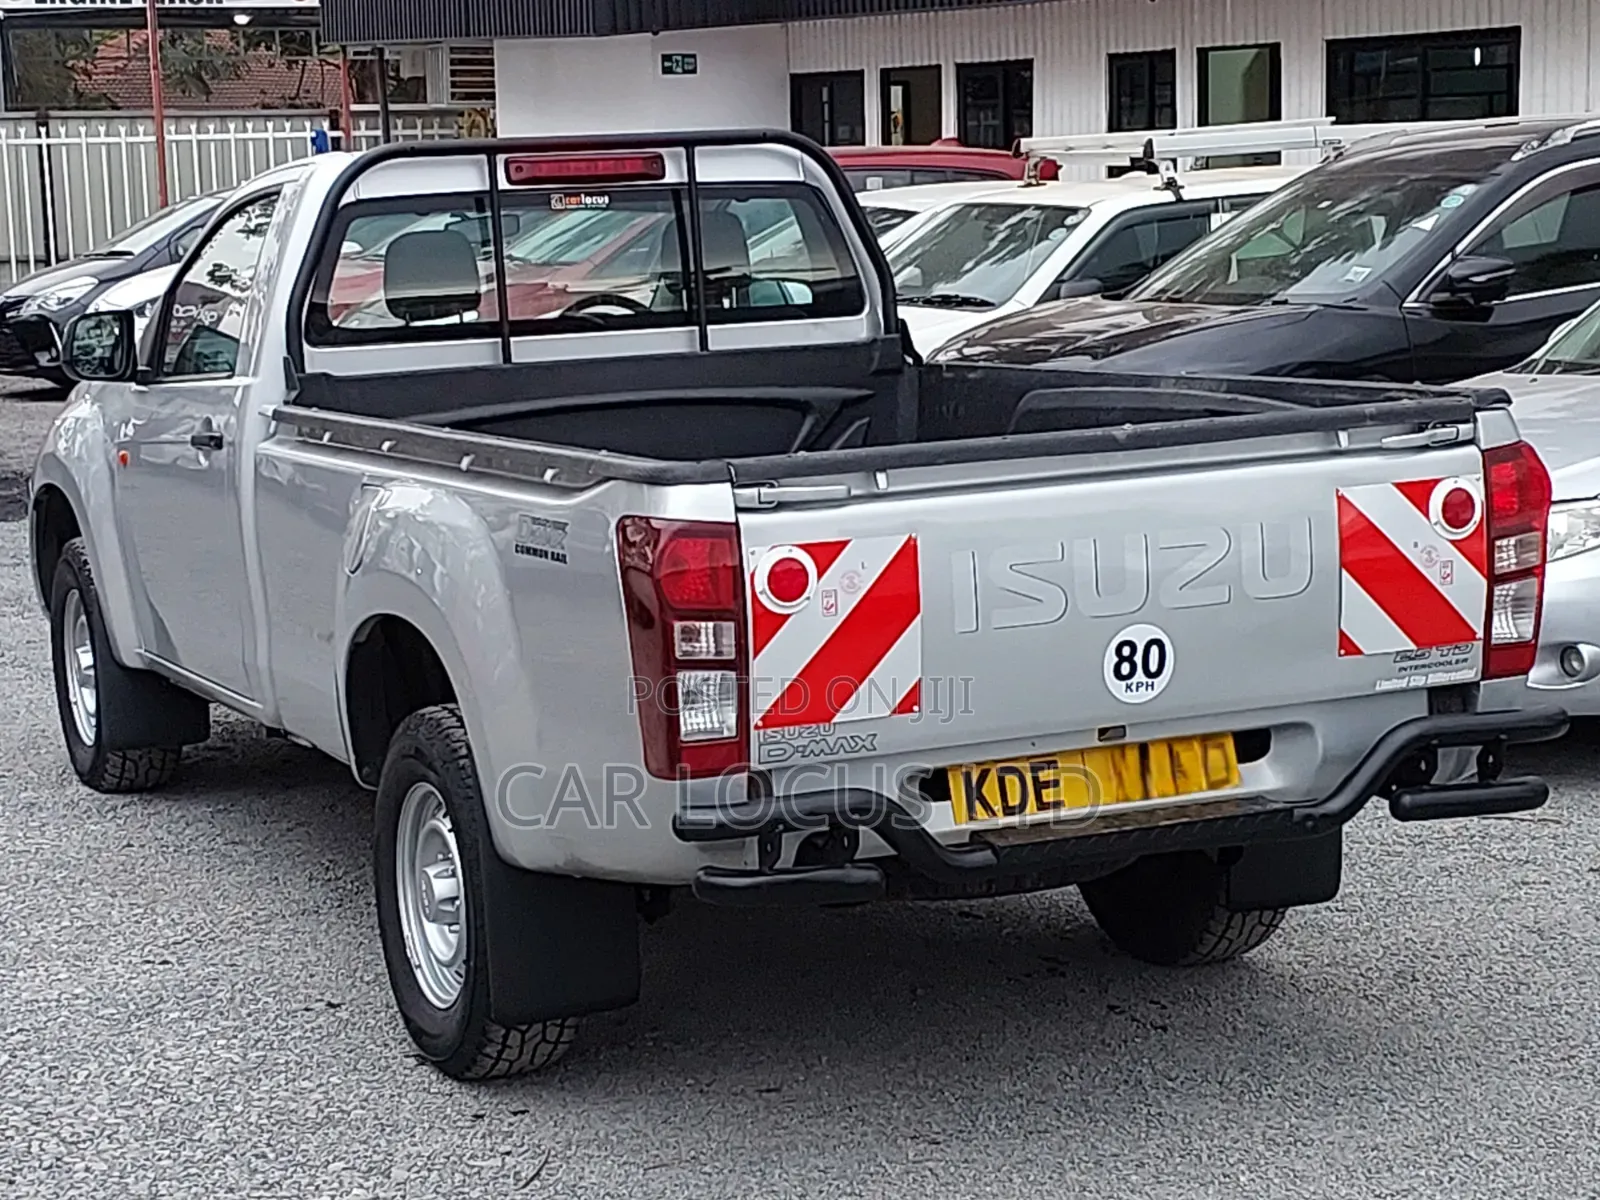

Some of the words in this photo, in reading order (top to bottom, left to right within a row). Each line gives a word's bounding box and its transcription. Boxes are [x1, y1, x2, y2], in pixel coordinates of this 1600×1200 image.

[514, 543, 549, 560] COMMON
[951, 517, 1313, 634] ISUZU
[1113, 637, 1167, 682] 80
[1397, 658, 1470, 673] INTERCOOLER
[1124, 681, 1155, 694] KPH
[758, 724, 836, 744] ISUZU
[758, 733, 878, 765] D-MAX
[961, 759, 1067, 822] KDE
